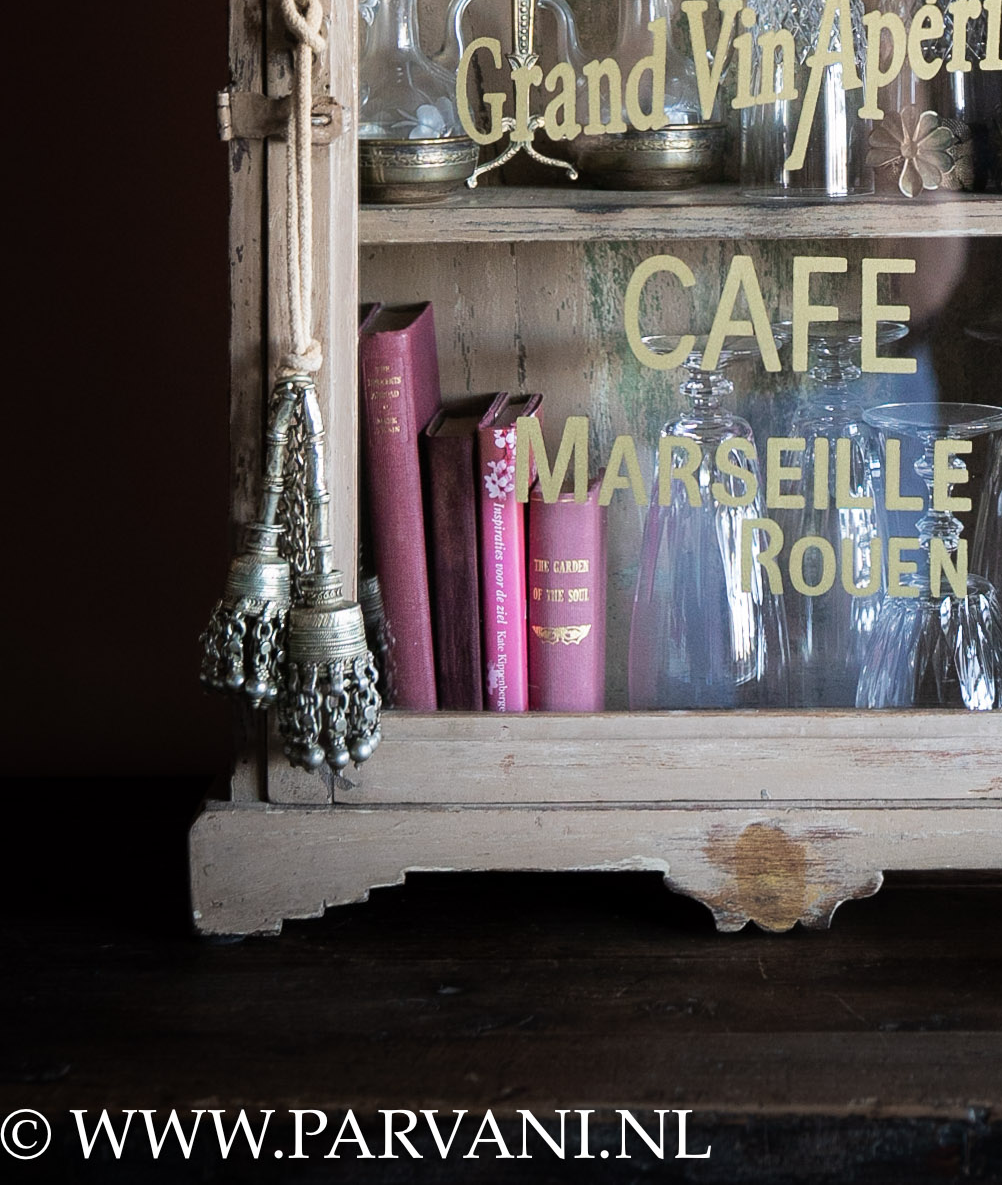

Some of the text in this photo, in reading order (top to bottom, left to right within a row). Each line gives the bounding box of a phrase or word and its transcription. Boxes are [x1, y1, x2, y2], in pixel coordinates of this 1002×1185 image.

[456, 16, 668, 145] Grand
[624, 254, 917, 374] CAFE
[515, 416, 973, 512] MARSEILLE
[533, 558, 590, 573] THE GARDEN
[740, 518, 969, 600] ROUEN
[495, 563, 504, 589] voor
[496, 589, 507, 603] de
[533, 587, 590, 602] OF THE SOUL
[496, 605, 508, 625] ziel
[496, 630, 507, 652] Kate
